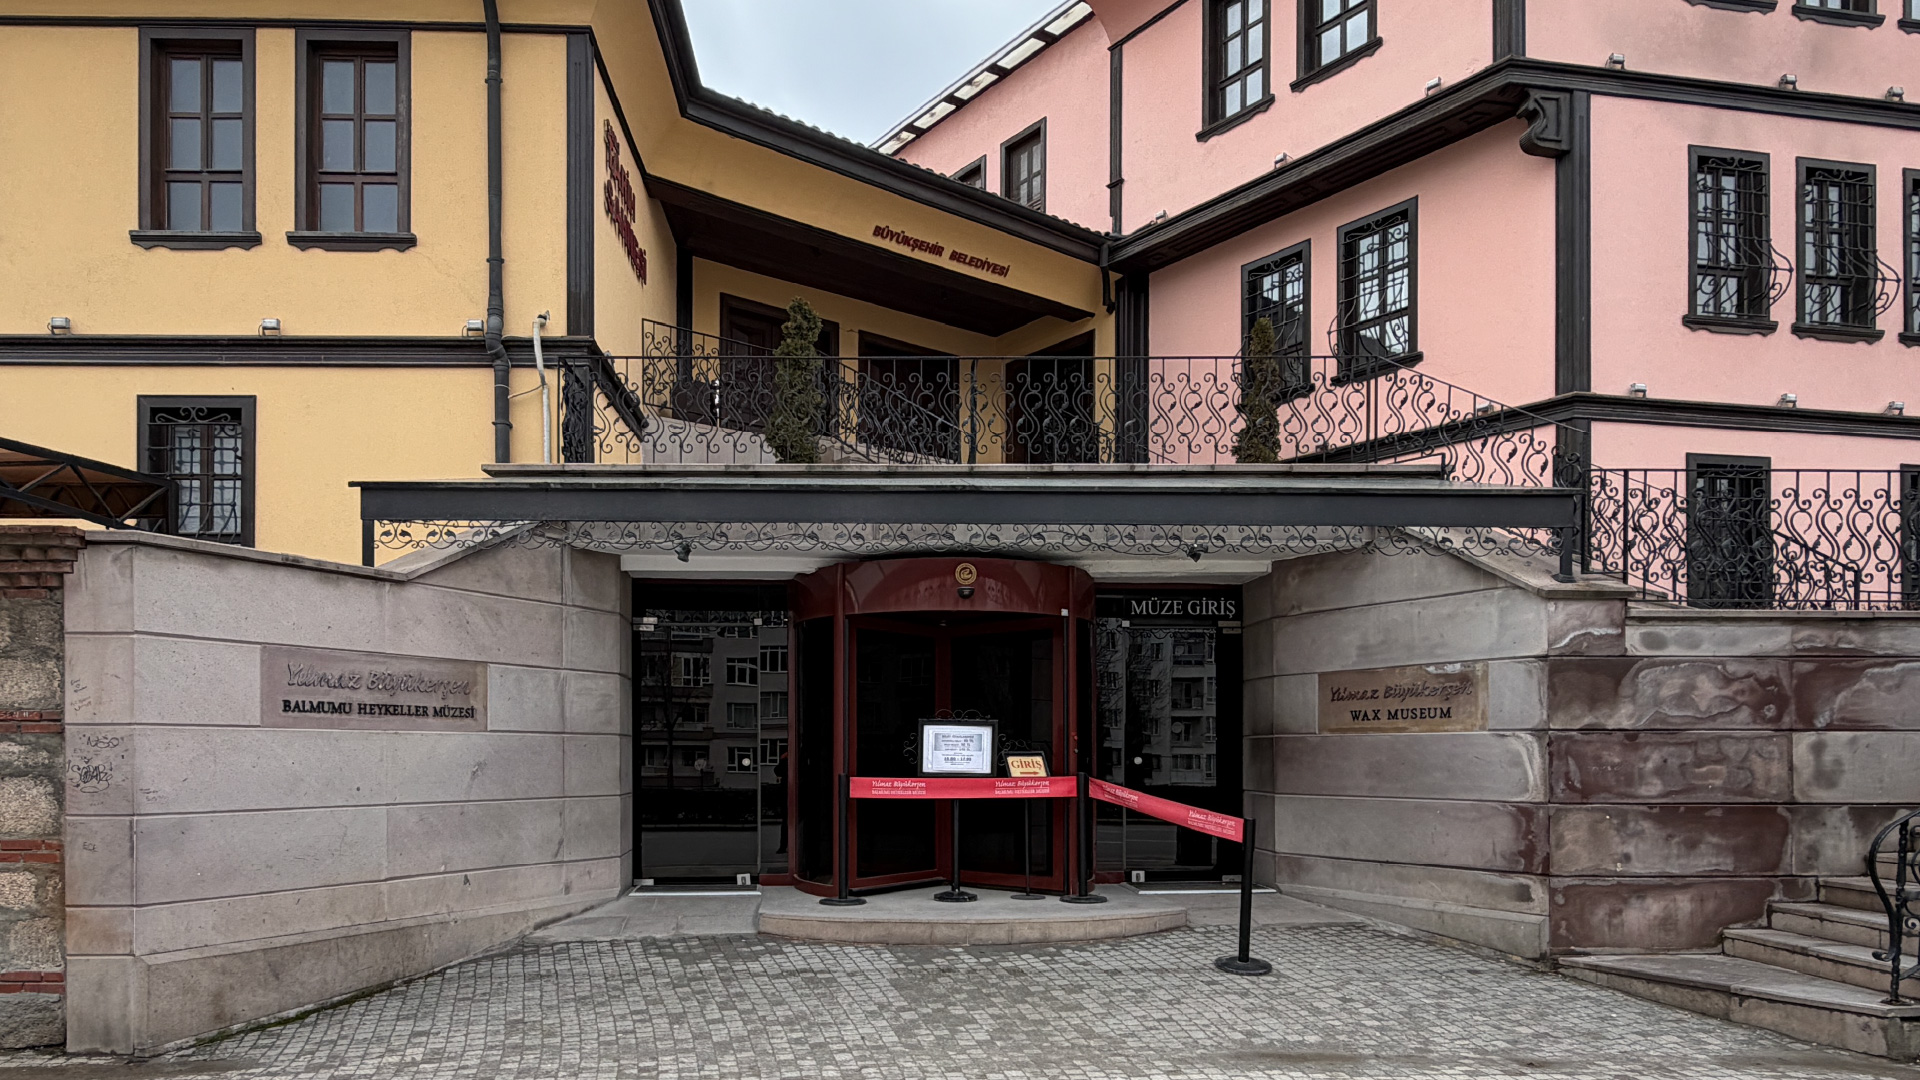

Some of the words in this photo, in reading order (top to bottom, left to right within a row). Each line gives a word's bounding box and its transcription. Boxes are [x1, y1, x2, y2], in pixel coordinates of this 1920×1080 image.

[872, 225, 945, 257] BÜYÜKŞEHİR
[948, 249, 1011, 278] BELEDİYESİ
[1130, 597, 1183, 616] MÜZE
[1187, 597, 1236, 618] GİRİŞ
[287, 661, 362, 690] Yılmaz
[367, 669, 473, 700] Büyükerşen
[1330, 686, 1380, 703] Yılmaz
[1383, 680, 1474, 703] Büyükerşen
[281, 699, 353, 714] BALMUMU
[357, 702, 429, 717] HEYKELLER
[432, 703, 477, 719] MÜZESİ
[1349, 709, 1381, 722] WAX
[1387, 707, 1453, 721] MUSEUM
[1011, 758, 1042, 770] GİRİŞ
